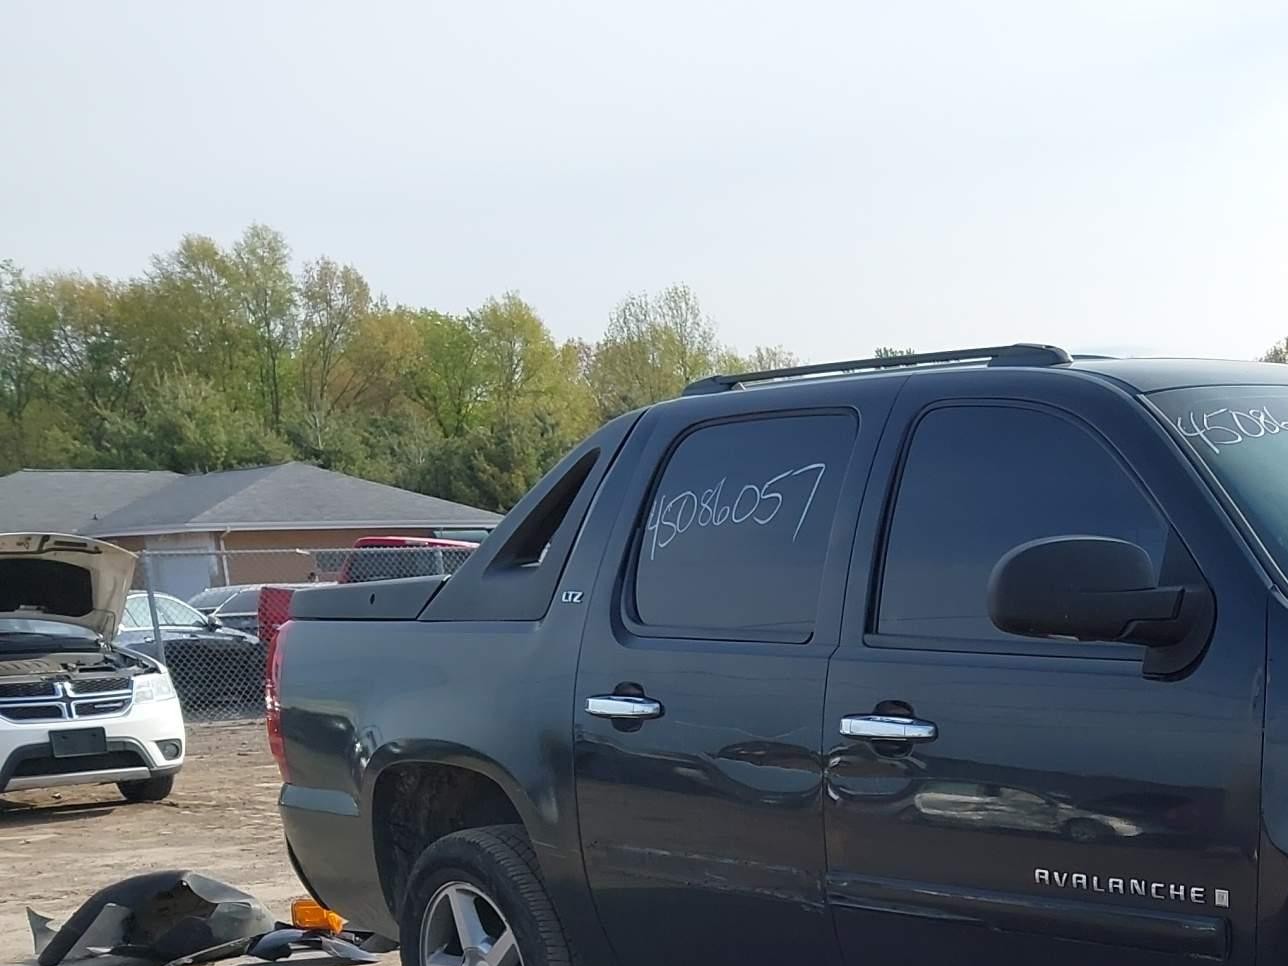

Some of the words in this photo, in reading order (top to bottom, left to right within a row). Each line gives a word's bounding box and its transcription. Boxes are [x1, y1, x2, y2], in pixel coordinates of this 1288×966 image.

[647, 463, 826, 560] 45086057
[561, 590, 584, 603] LTZ
[1034, 868, 1207, 904] AVALANCHE
